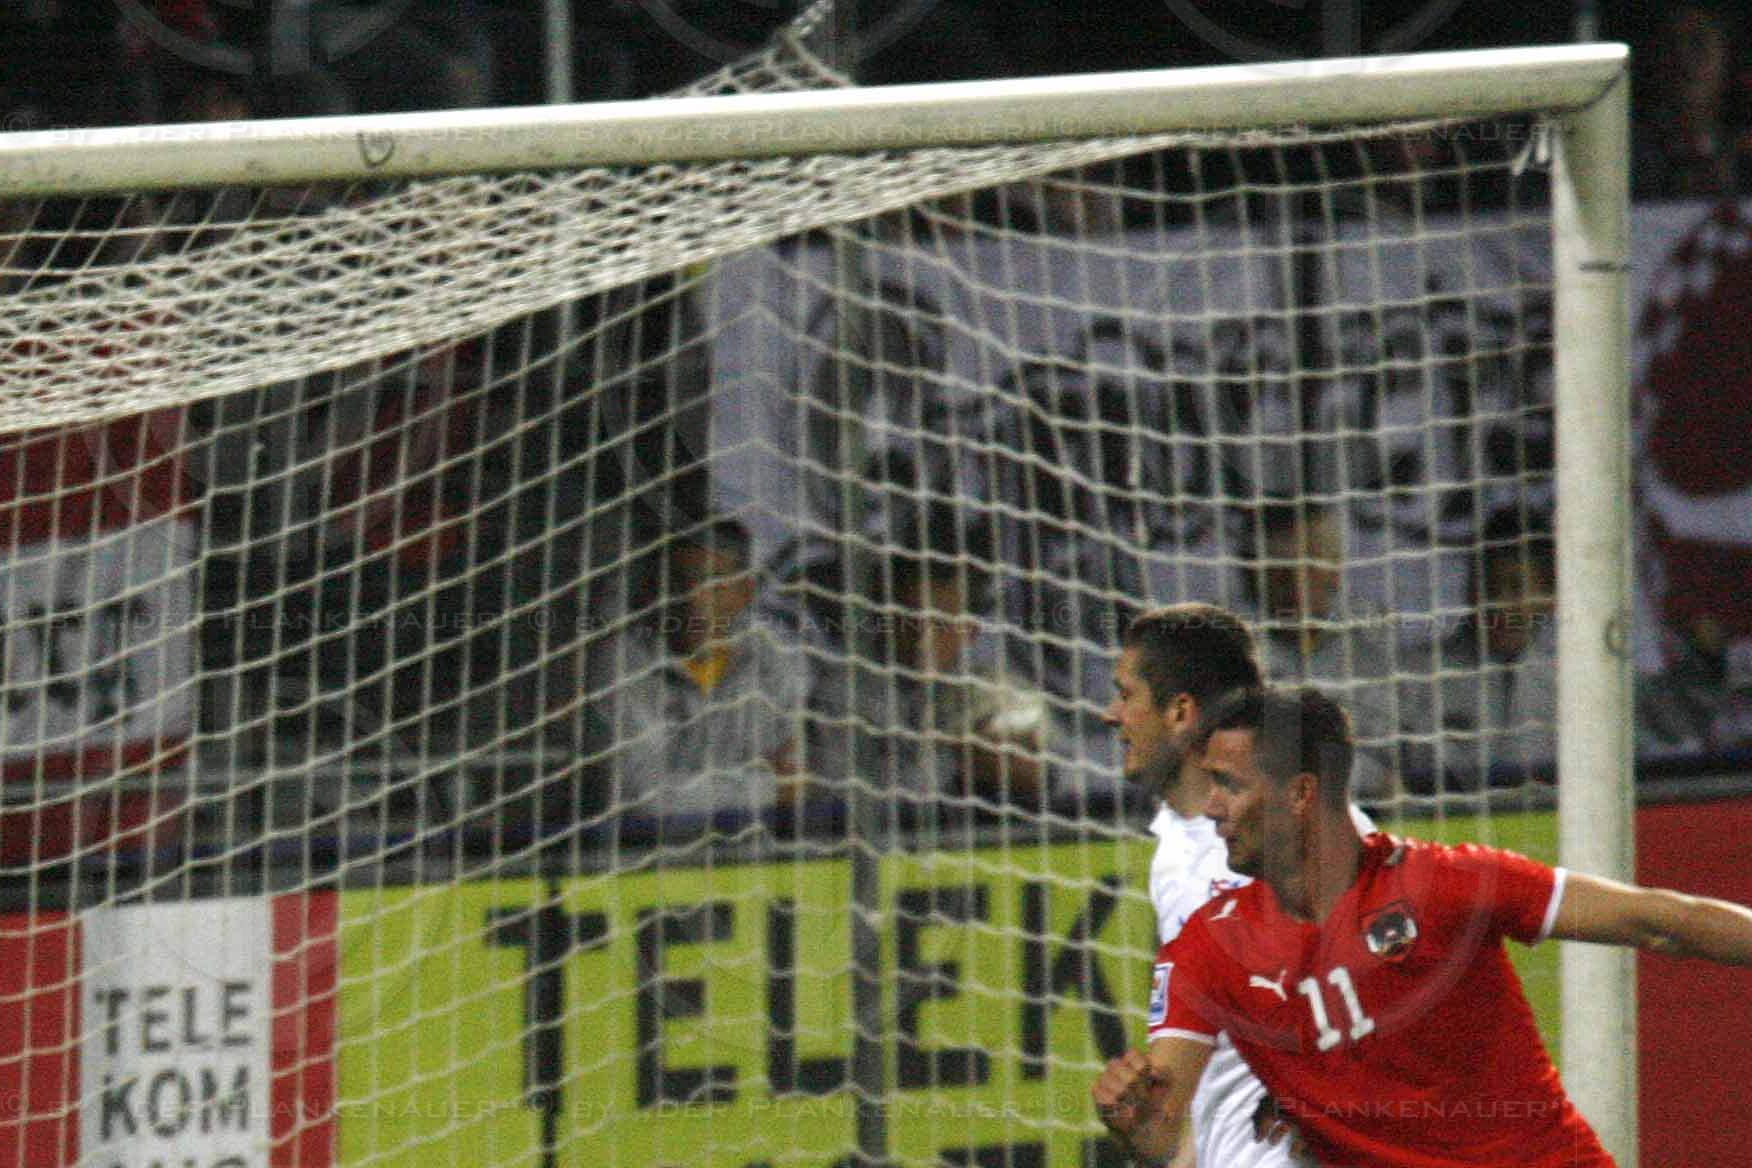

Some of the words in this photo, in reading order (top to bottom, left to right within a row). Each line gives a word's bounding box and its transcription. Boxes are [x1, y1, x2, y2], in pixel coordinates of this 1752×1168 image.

[95, 981, 251, 1053] TELE
[1297, 966, 1375, 1050] 11
[100, 1066, 249, 1141] KOM
